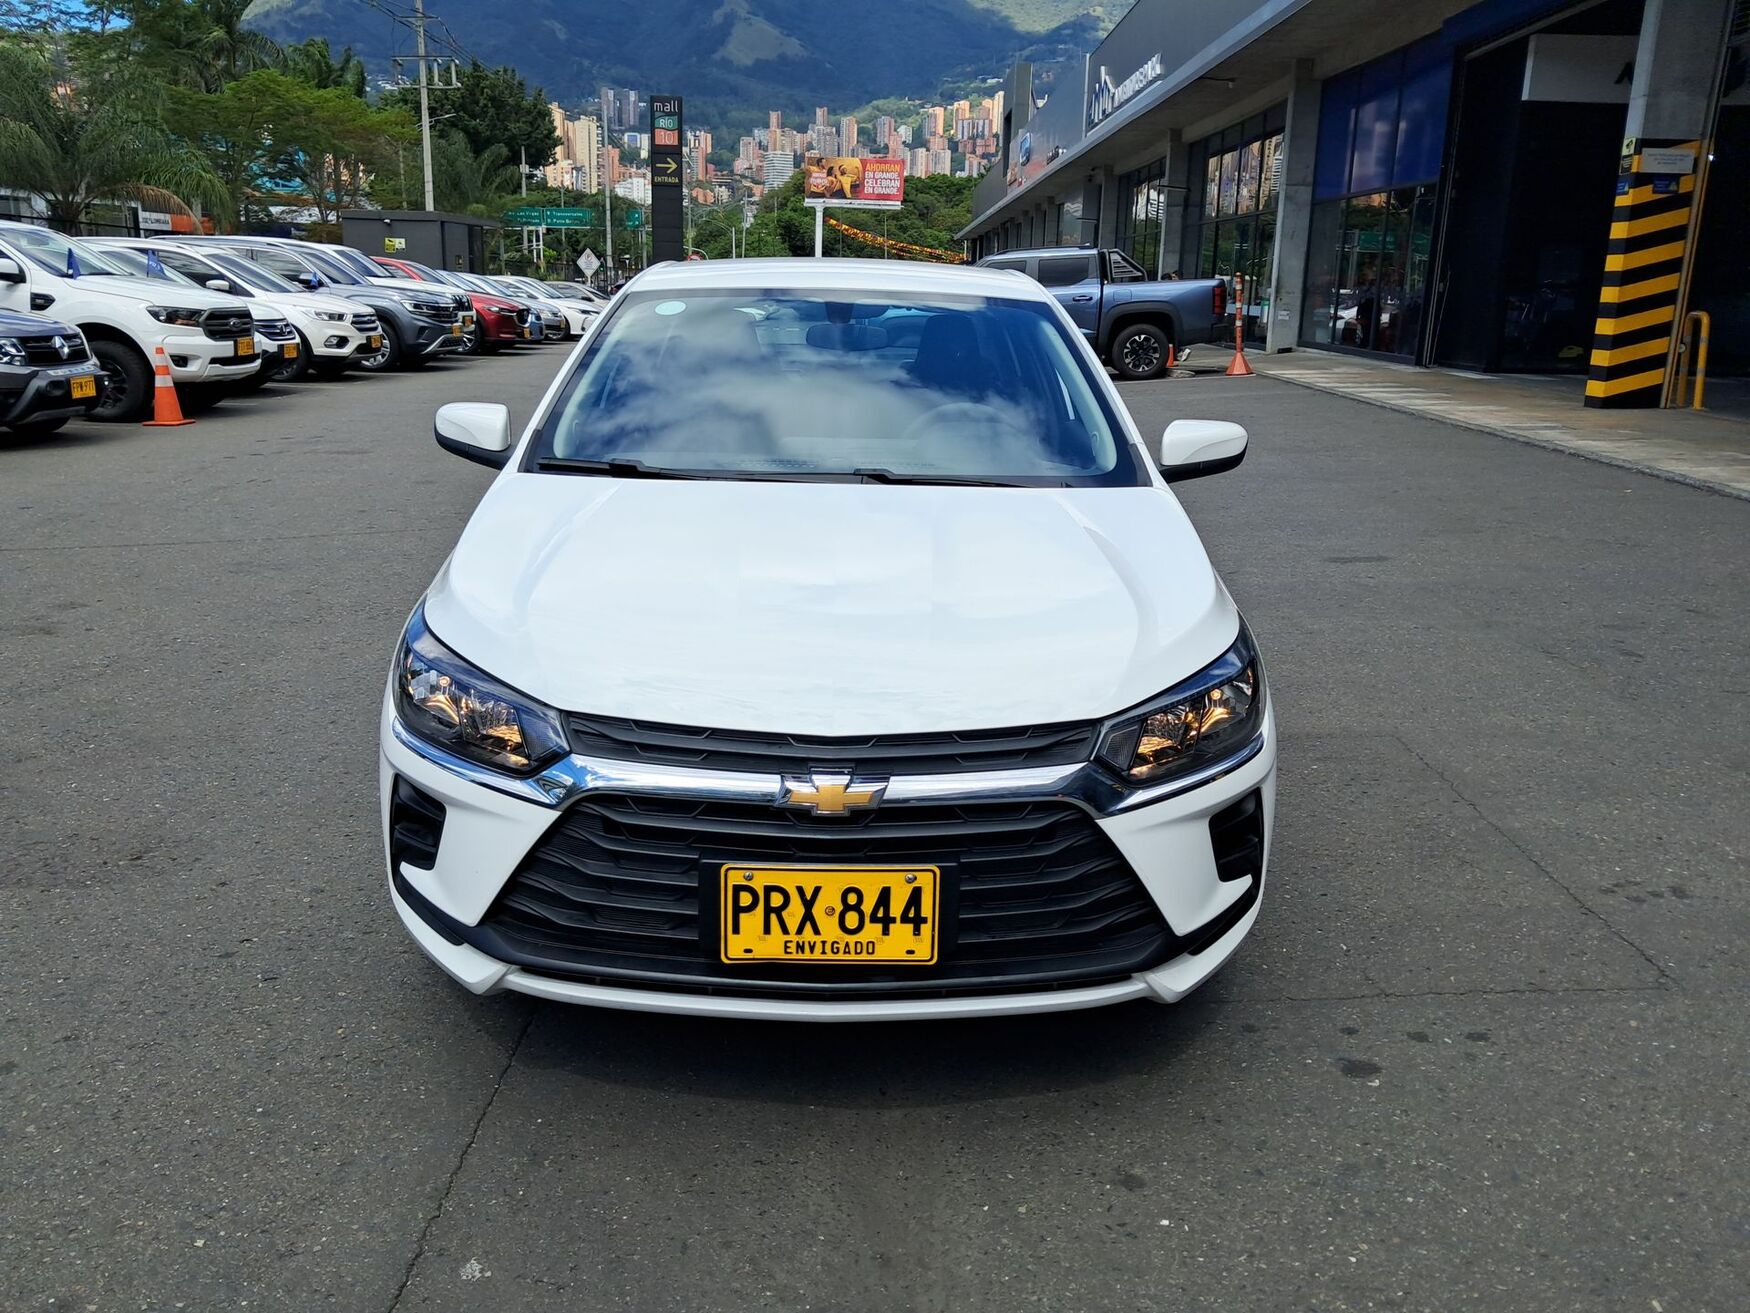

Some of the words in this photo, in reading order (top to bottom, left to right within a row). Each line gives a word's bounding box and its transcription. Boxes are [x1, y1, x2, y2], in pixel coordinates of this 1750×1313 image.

[653, 100, 679, 112] mall
[865, 163, 900, 172] AHORRAN
[864, 179, 900, 187] CELEBRAN
[864, 186, 873, 194] EN
[731, 884, 823, 936] PRX
[837, 886, 929, 936] 844
[783, 940, 876, 956] ENVIGADO
